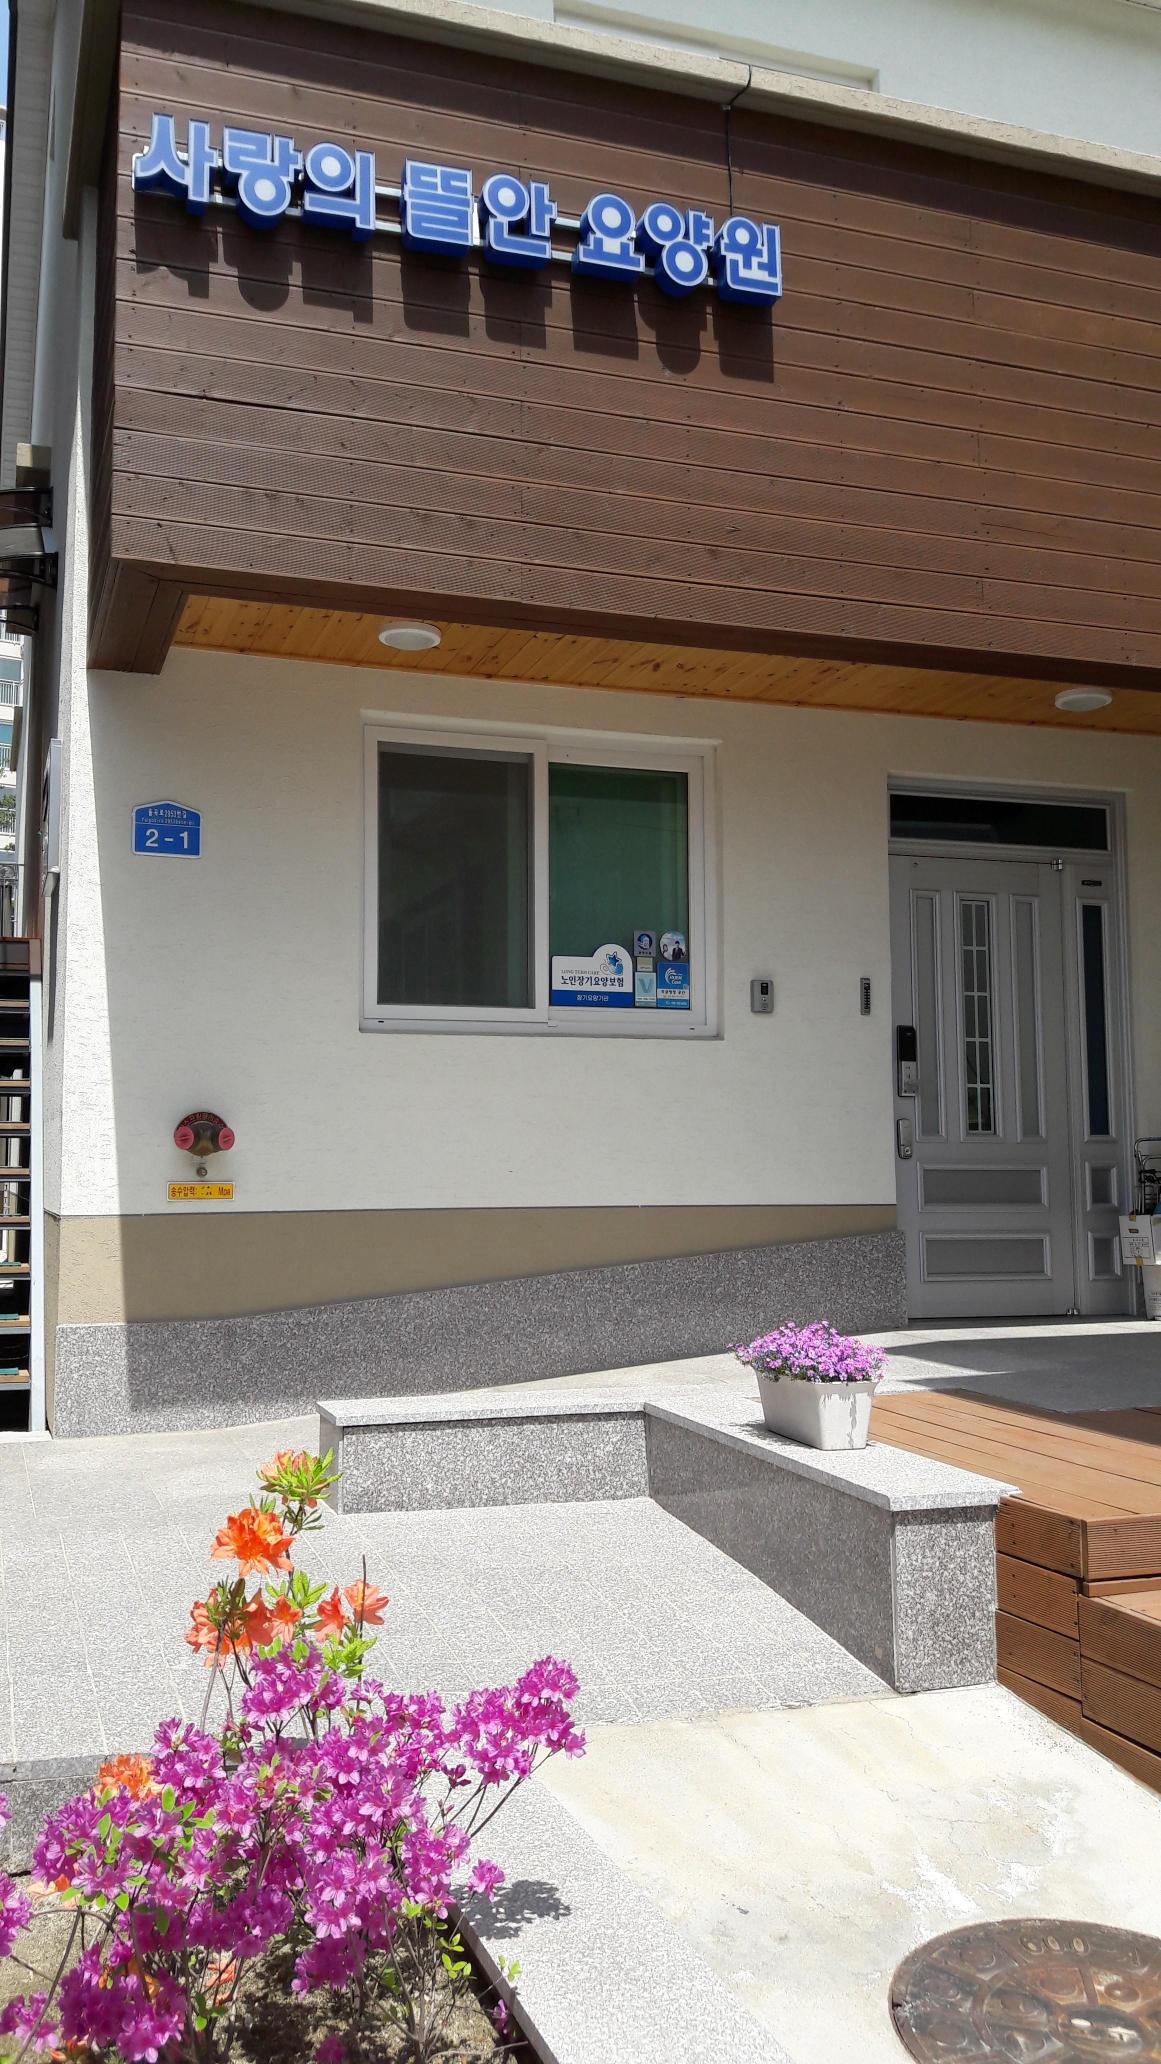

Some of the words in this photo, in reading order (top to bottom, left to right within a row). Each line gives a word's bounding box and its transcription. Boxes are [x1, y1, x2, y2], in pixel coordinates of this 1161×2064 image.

[132, 111, 377, 232] 사랑의
[402, 156, 558, 262] 뜰안
[576, 191, 784, 299] 요양원
[145, 828, 188, 849] 2-1
[560, 975, 624, 988] 노인장기요양보험
[576, 994, 609, 1002] 장기요양기관
